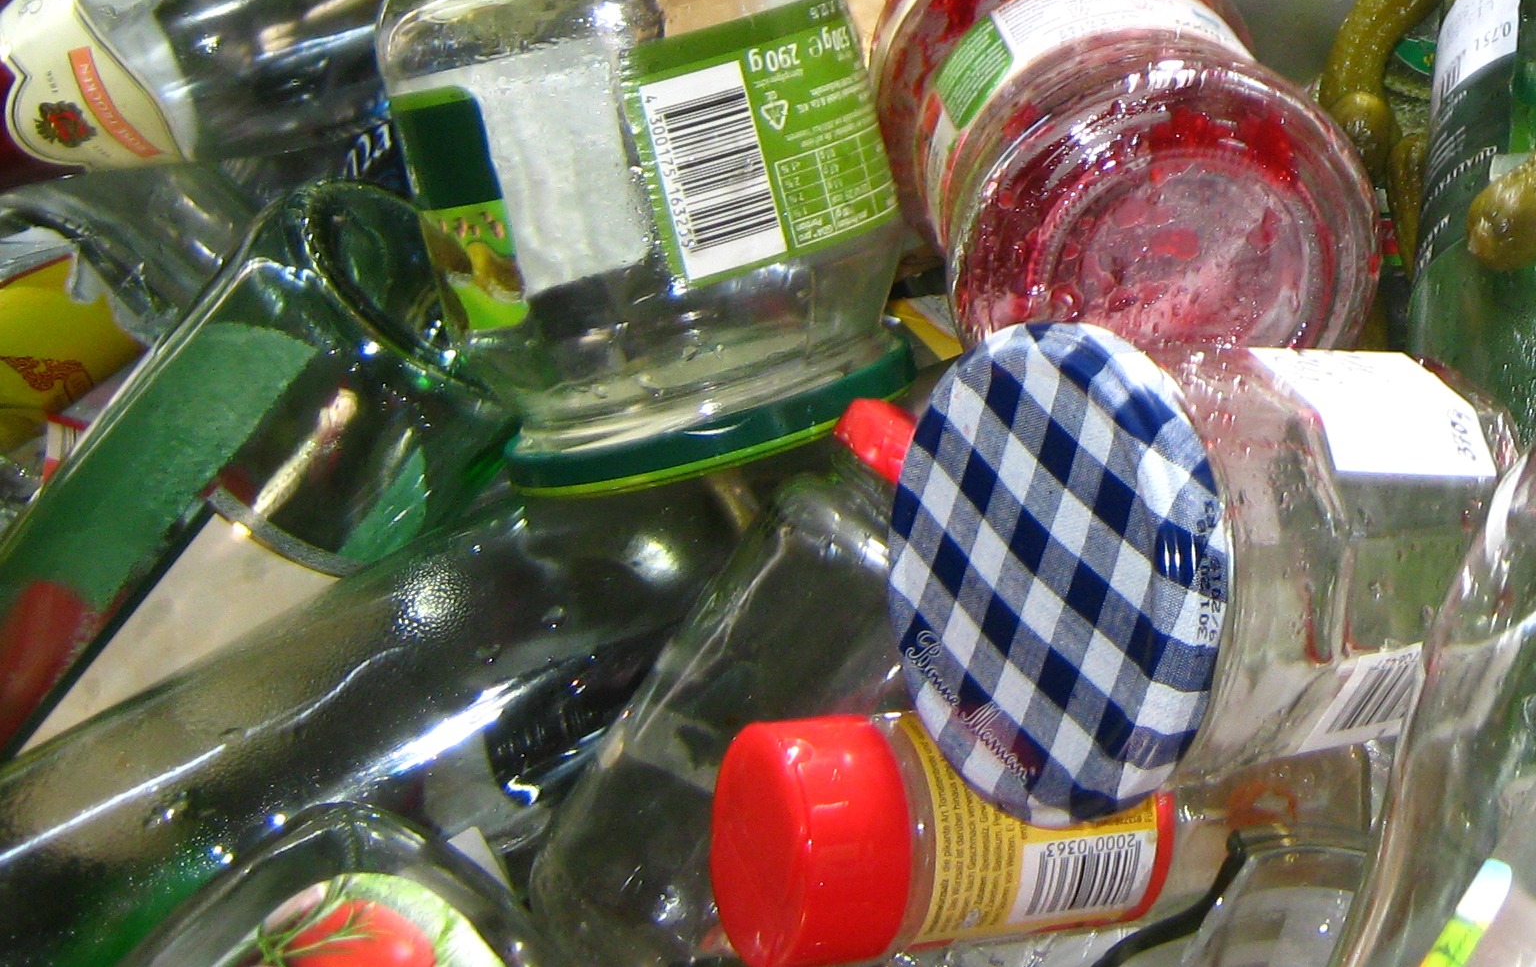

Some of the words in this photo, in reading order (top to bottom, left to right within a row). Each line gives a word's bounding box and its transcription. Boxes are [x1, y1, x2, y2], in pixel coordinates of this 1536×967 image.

[746, 47, 764, 72] g
[763, 42, 801, 72] 290
[648, 117, 671, 176] 300175
[906, 629, 963, 719] Bonne
[951, 700, 1036, 786] Maman
[1047, 838, 1086, 856] 0363
[1096, 833, 1135, 849] 2000
